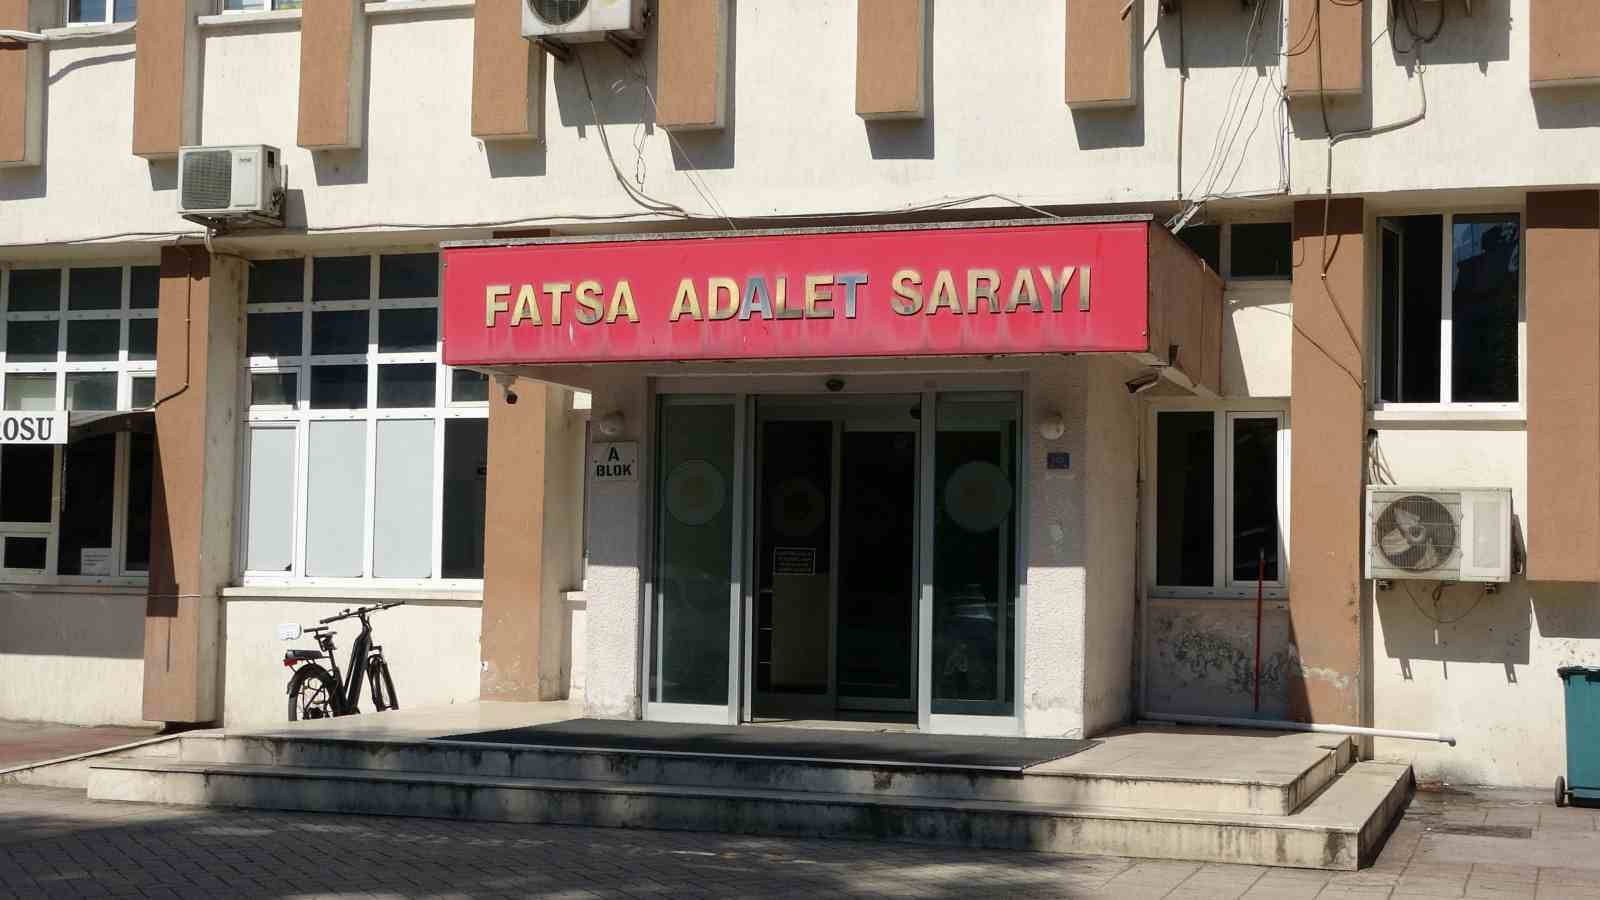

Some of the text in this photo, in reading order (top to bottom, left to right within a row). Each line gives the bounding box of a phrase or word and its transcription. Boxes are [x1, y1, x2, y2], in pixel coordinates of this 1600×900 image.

[485, 265, 1091, 327] FATSA ADALET SARAYI
[0, 416, 54, 441] OSU
[608, 447, 620, 461] A
[596, 464, 632, 477] BLOK
